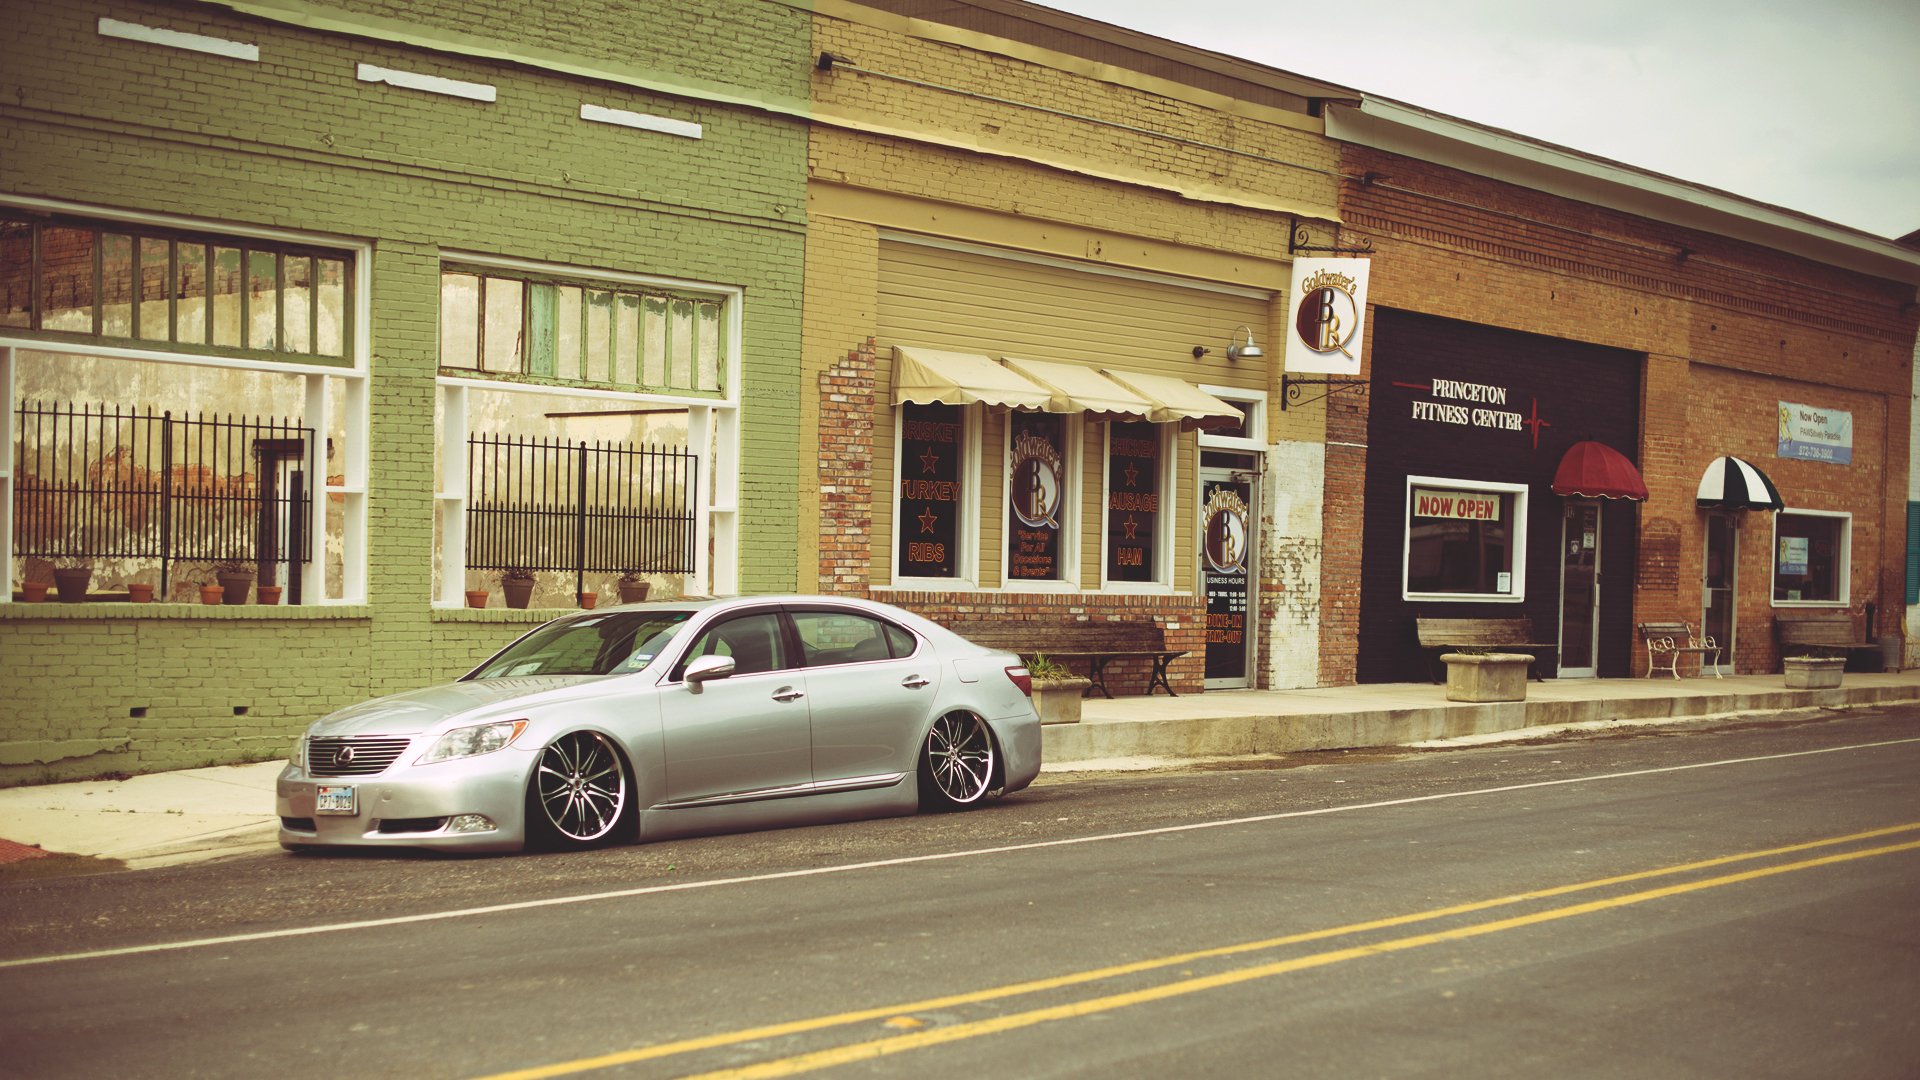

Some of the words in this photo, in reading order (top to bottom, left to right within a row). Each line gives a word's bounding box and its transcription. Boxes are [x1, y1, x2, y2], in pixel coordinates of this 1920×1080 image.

[1302, 268, 1357, 295] Goldwater's
[1432, 379, 1507, 405] PRINCETON
[1412, 401, 1469, 425] FITNESS
[1472, 408, 1522, 431] CENTER
[1800, 410, 1812, 422] Now
[1813, 412, 1828, 426] Open
[901, 420, 960, 442] BRISKET
[900, 479, 960, 501] TURKEY
[1108, 491, 1158, 513] AUSAGE
[1418, 496, 1453, 516] NOW
[1457, 498, 1494, 518] OPEN
[908, 542, 945, 562] RIBS
[1117, 547, 1143, 565] HAM
[1228, 577, 1245, 585] HOURS
[1206, 613, 1242, 628] DINE-IN
[1206, 629, 1242, 643] TAKE-OUT
